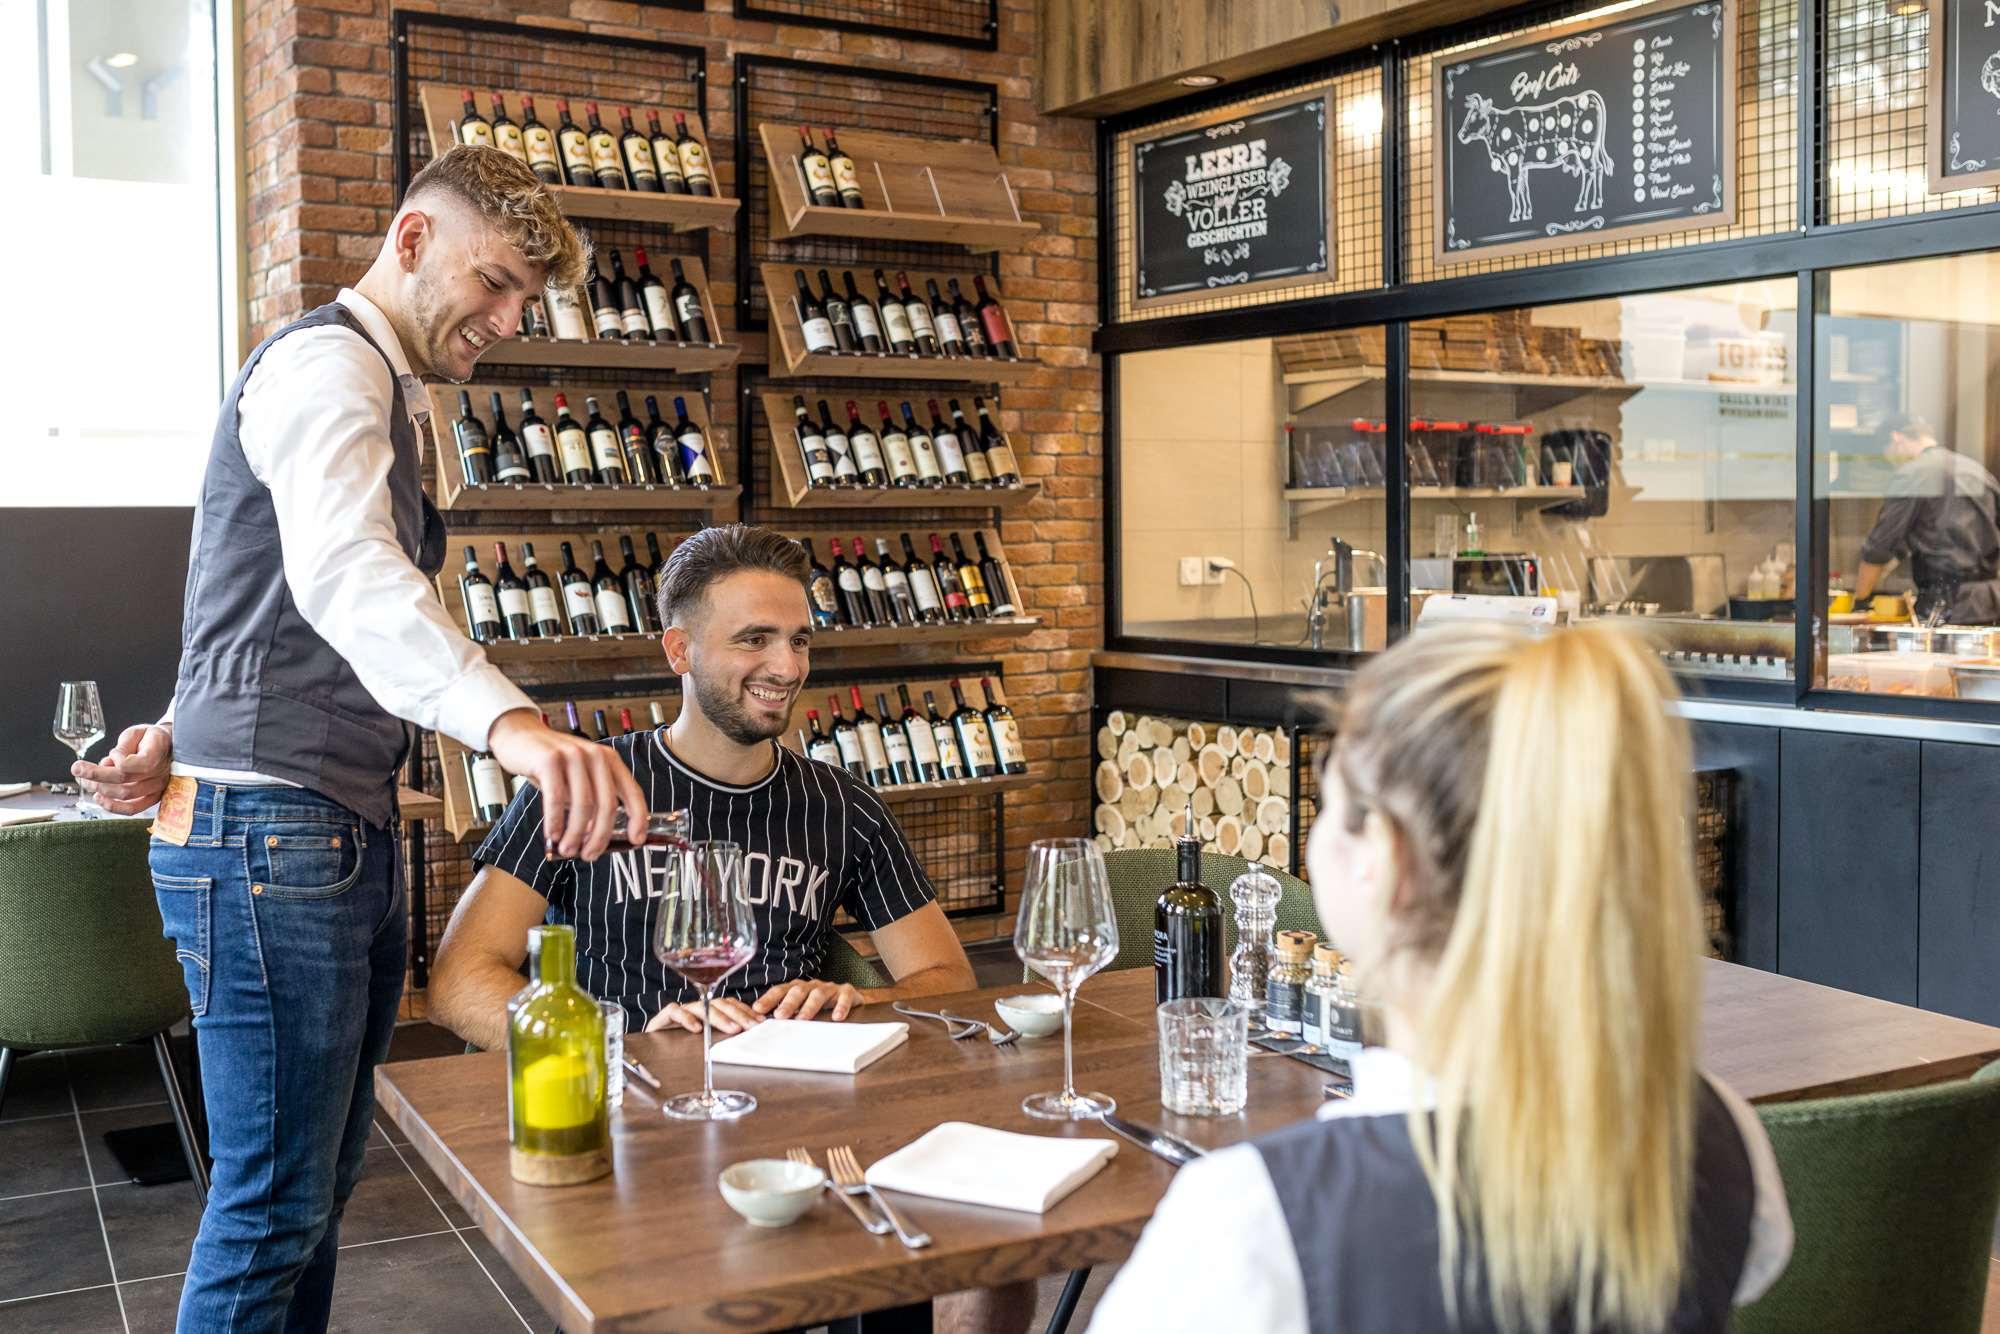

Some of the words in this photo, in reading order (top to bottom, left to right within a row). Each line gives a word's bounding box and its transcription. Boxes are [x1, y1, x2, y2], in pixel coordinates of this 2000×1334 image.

[1185, 139, 1267, 183] LEERE
[1186, 198, 1268, 232] VOLLER
[611, 845, 703, 904] NEW
[714, 848, 830, 921] YORK
